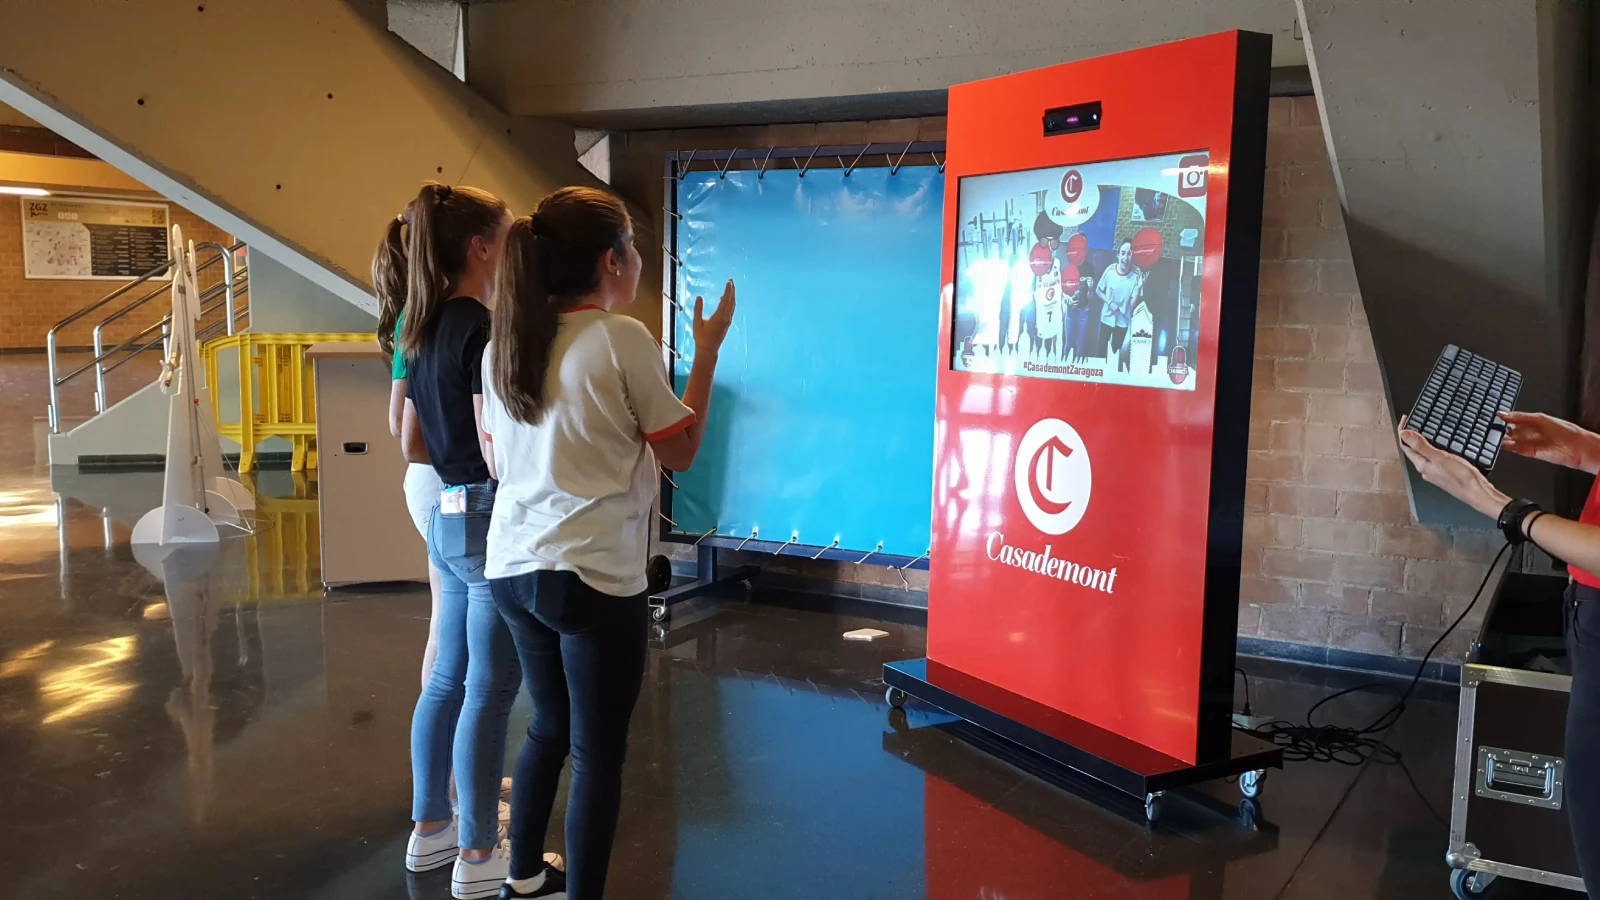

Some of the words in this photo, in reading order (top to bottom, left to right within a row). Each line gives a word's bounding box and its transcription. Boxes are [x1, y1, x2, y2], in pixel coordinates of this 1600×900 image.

[29, 202, 48, 212] ZGZ
[1023, 361, 1104, 378] #CasademontZaragoza
[986, 531, 1118, 594] Casademont
